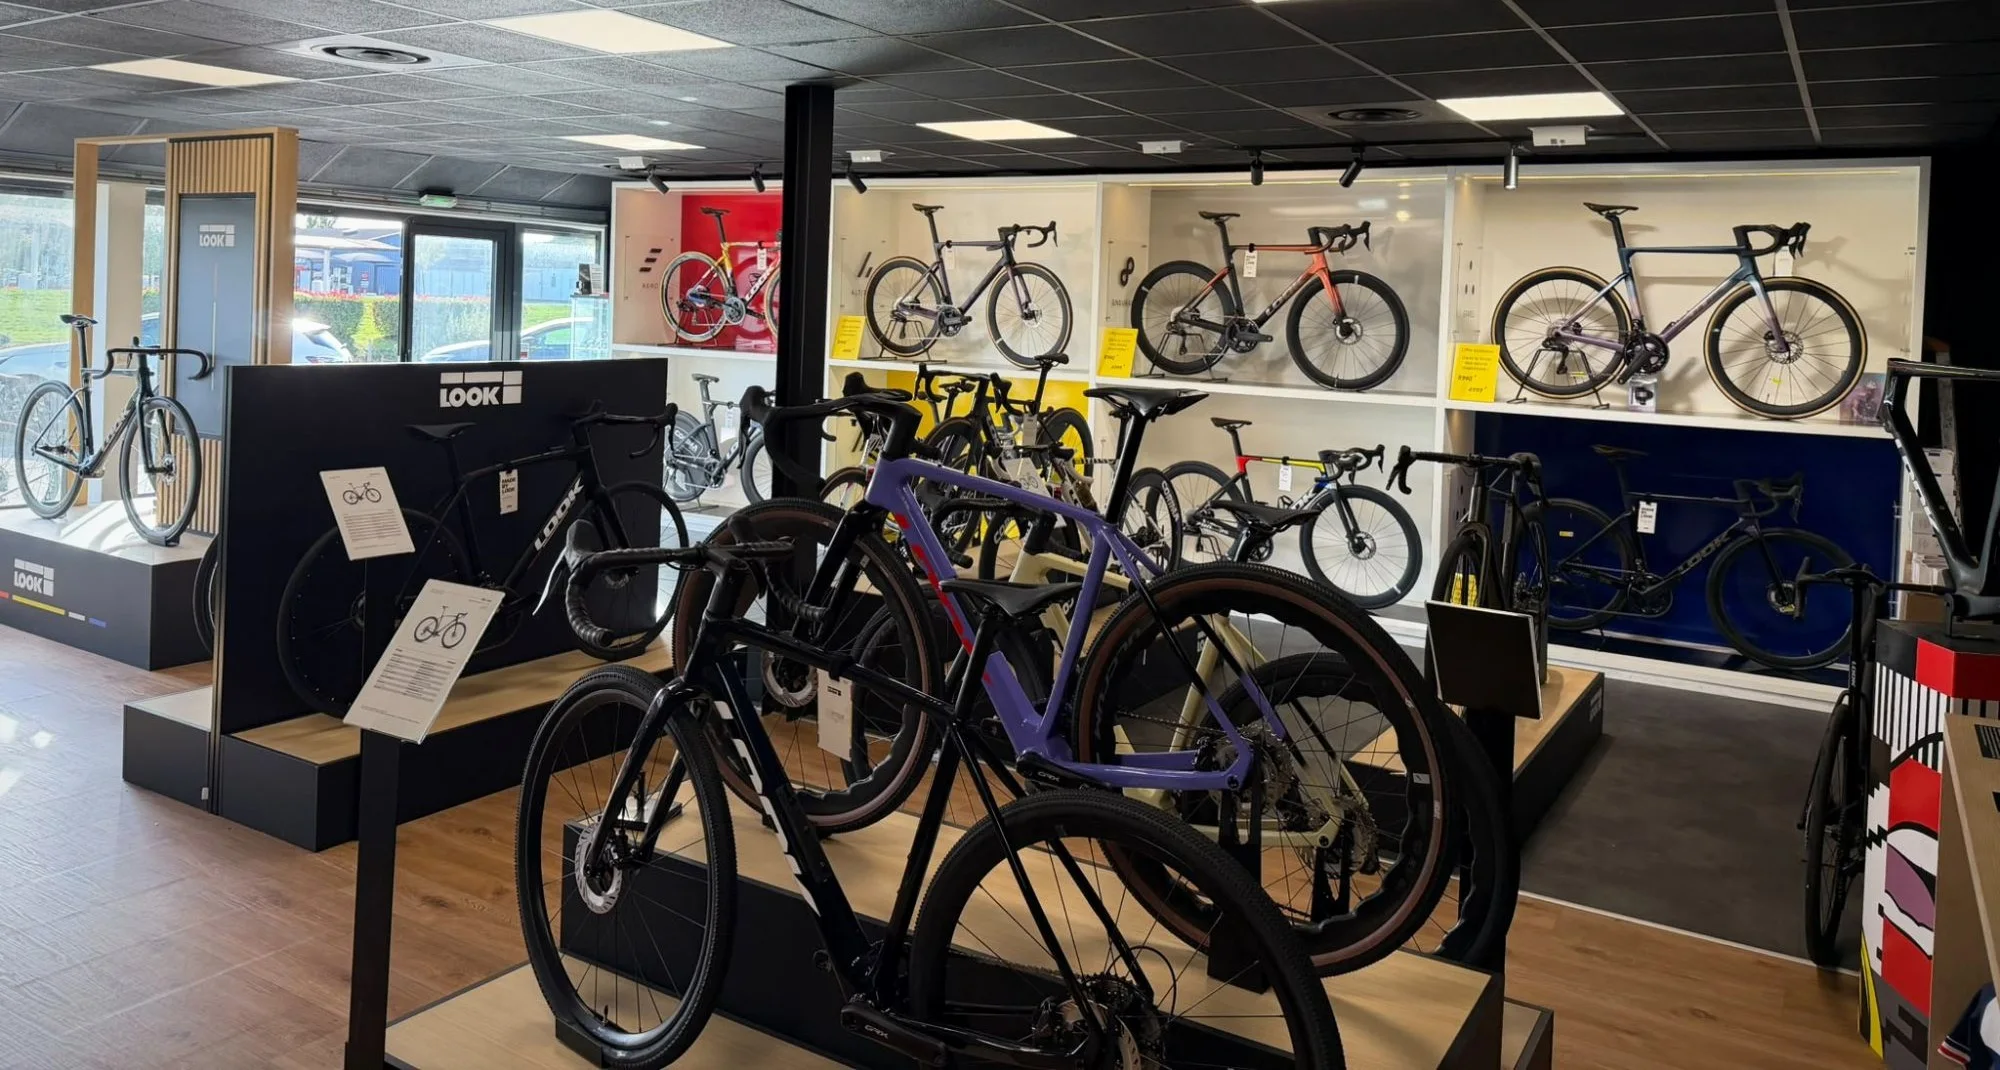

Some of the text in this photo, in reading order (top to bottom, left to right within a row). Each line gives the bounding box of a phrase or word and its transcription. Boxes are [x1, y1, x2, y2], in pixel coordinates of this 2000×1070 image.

[199, 233, 225, 247] LOOK
[440, 386, 500, 408] LOOK
[1161, 480, 1180, 522] CORIMA
[534, 478, 584, 551] LOOK
[1679, 531, 1731, 575] LOOK
[14, 570, 43, 594] LOOK
[864, 1024, 889, 1039] GRX
